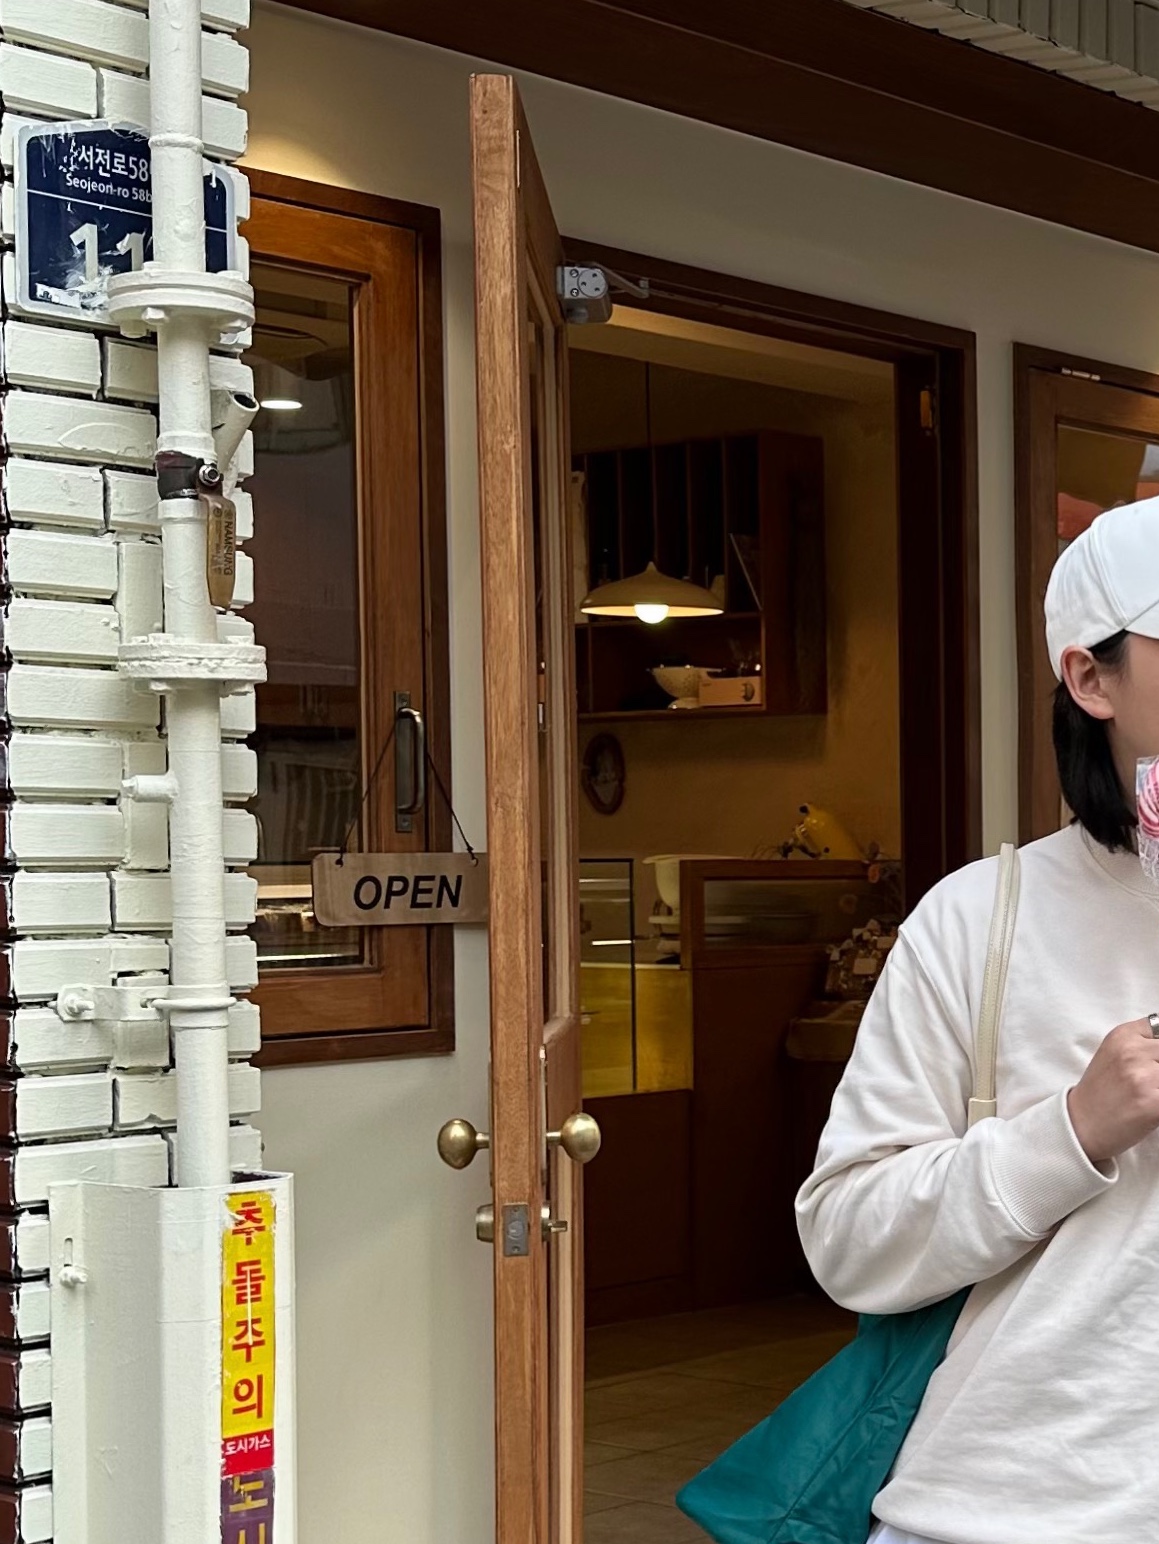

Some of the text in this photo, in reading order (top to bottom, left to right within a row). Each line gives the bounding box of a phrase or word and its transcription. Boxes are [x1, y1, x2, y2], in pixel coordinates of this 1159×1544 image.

[65, 173, 130, 198] Seojeon-ro
[69, 223, 153, 281] 11
[354, 875, 463, 910] OPEN
